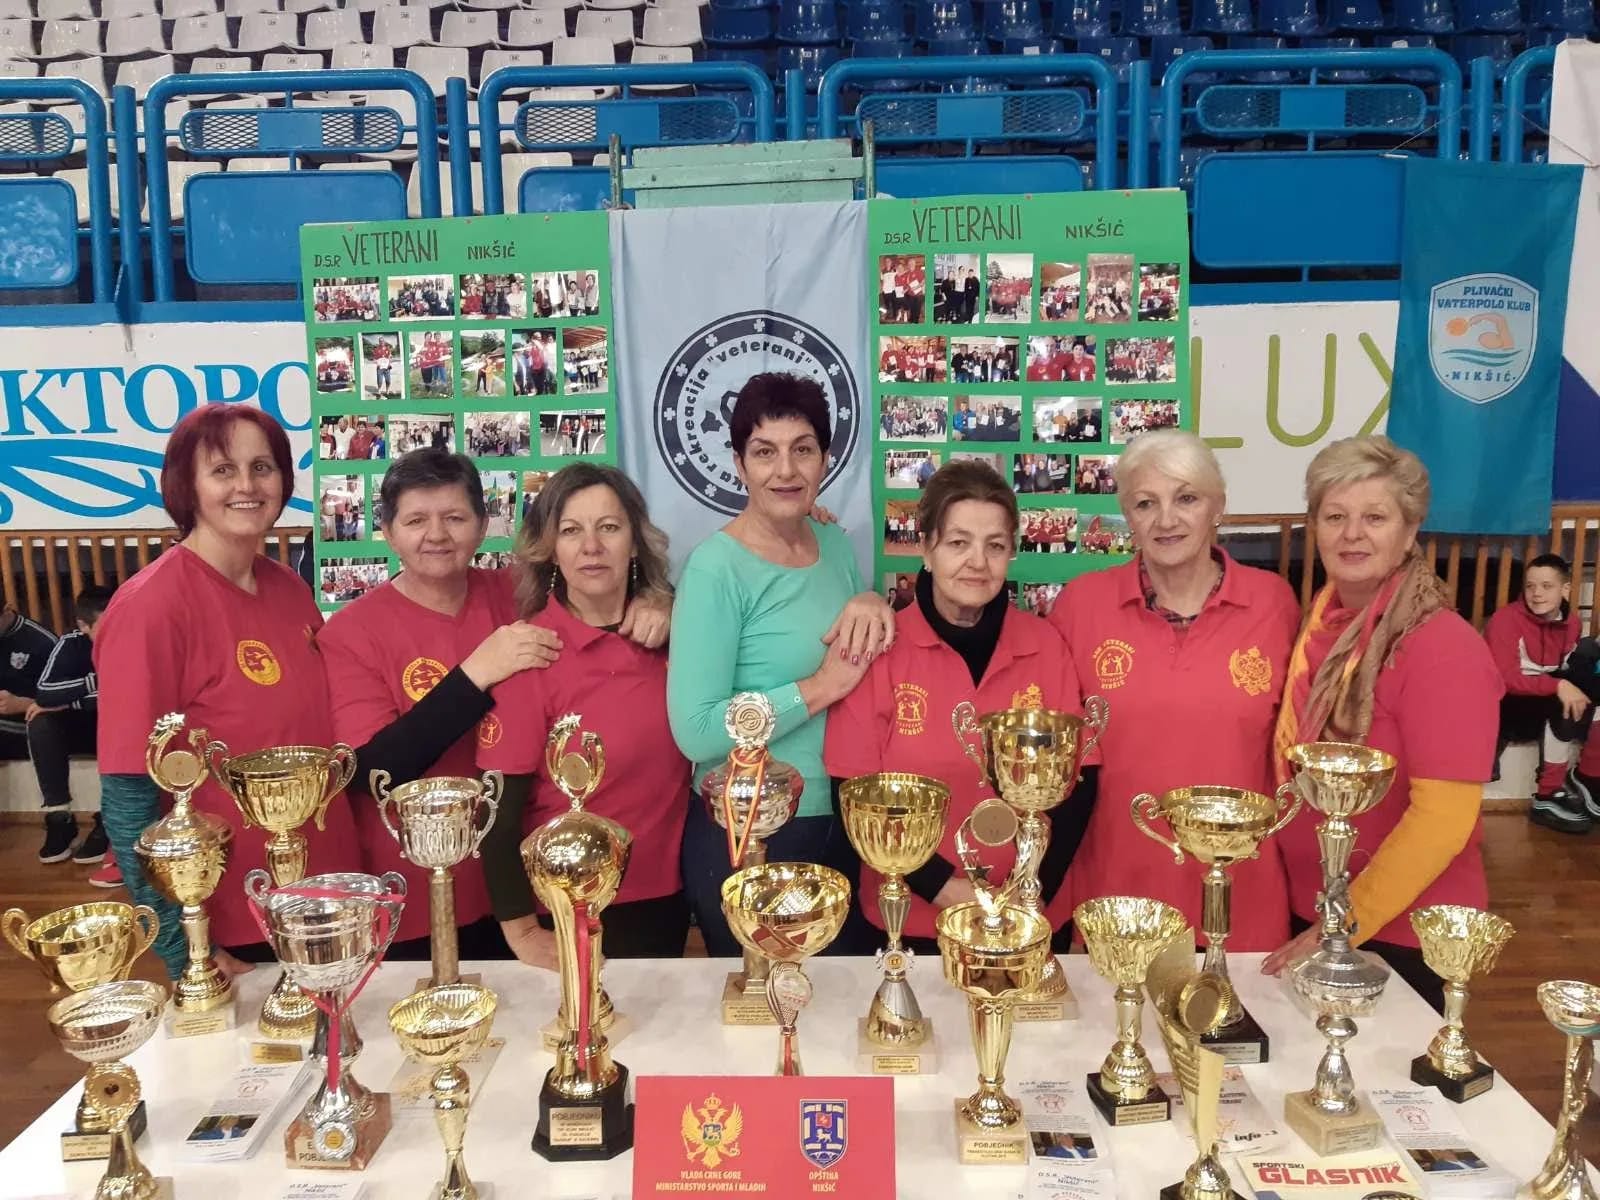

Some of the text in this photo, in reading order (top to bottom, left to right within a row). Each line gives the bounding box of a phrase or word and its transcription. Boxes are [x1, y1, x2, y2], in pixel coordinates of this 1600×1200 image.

[912, 204, 1022, 243] VETERANI
[342, 229, 439, 267] VETERANI
[1463, 284, 1514, 297] PLIVAČKI
[1437, 298, 1531, 312] VATERPOLO KLUB
[1451, 369, 1513, 382] NIKŠIĆ
[683, 367, 718, 473] rekreacija
[1252, 1161, 1305, 1170] SPORTSKI
[680, 1170, 742, 1180] VLADA CRNE GORE
[808, 1169, 839, 1181] OPŠTINA
[1257, 1166, 1409, 1186] GLASNIK
[655, 1181, 706, 1192] MINISTARSTVO
[706, 1181, 734, 1192] SPORTA
[812, 1181, 836, 1192] NIKŠIĆ
